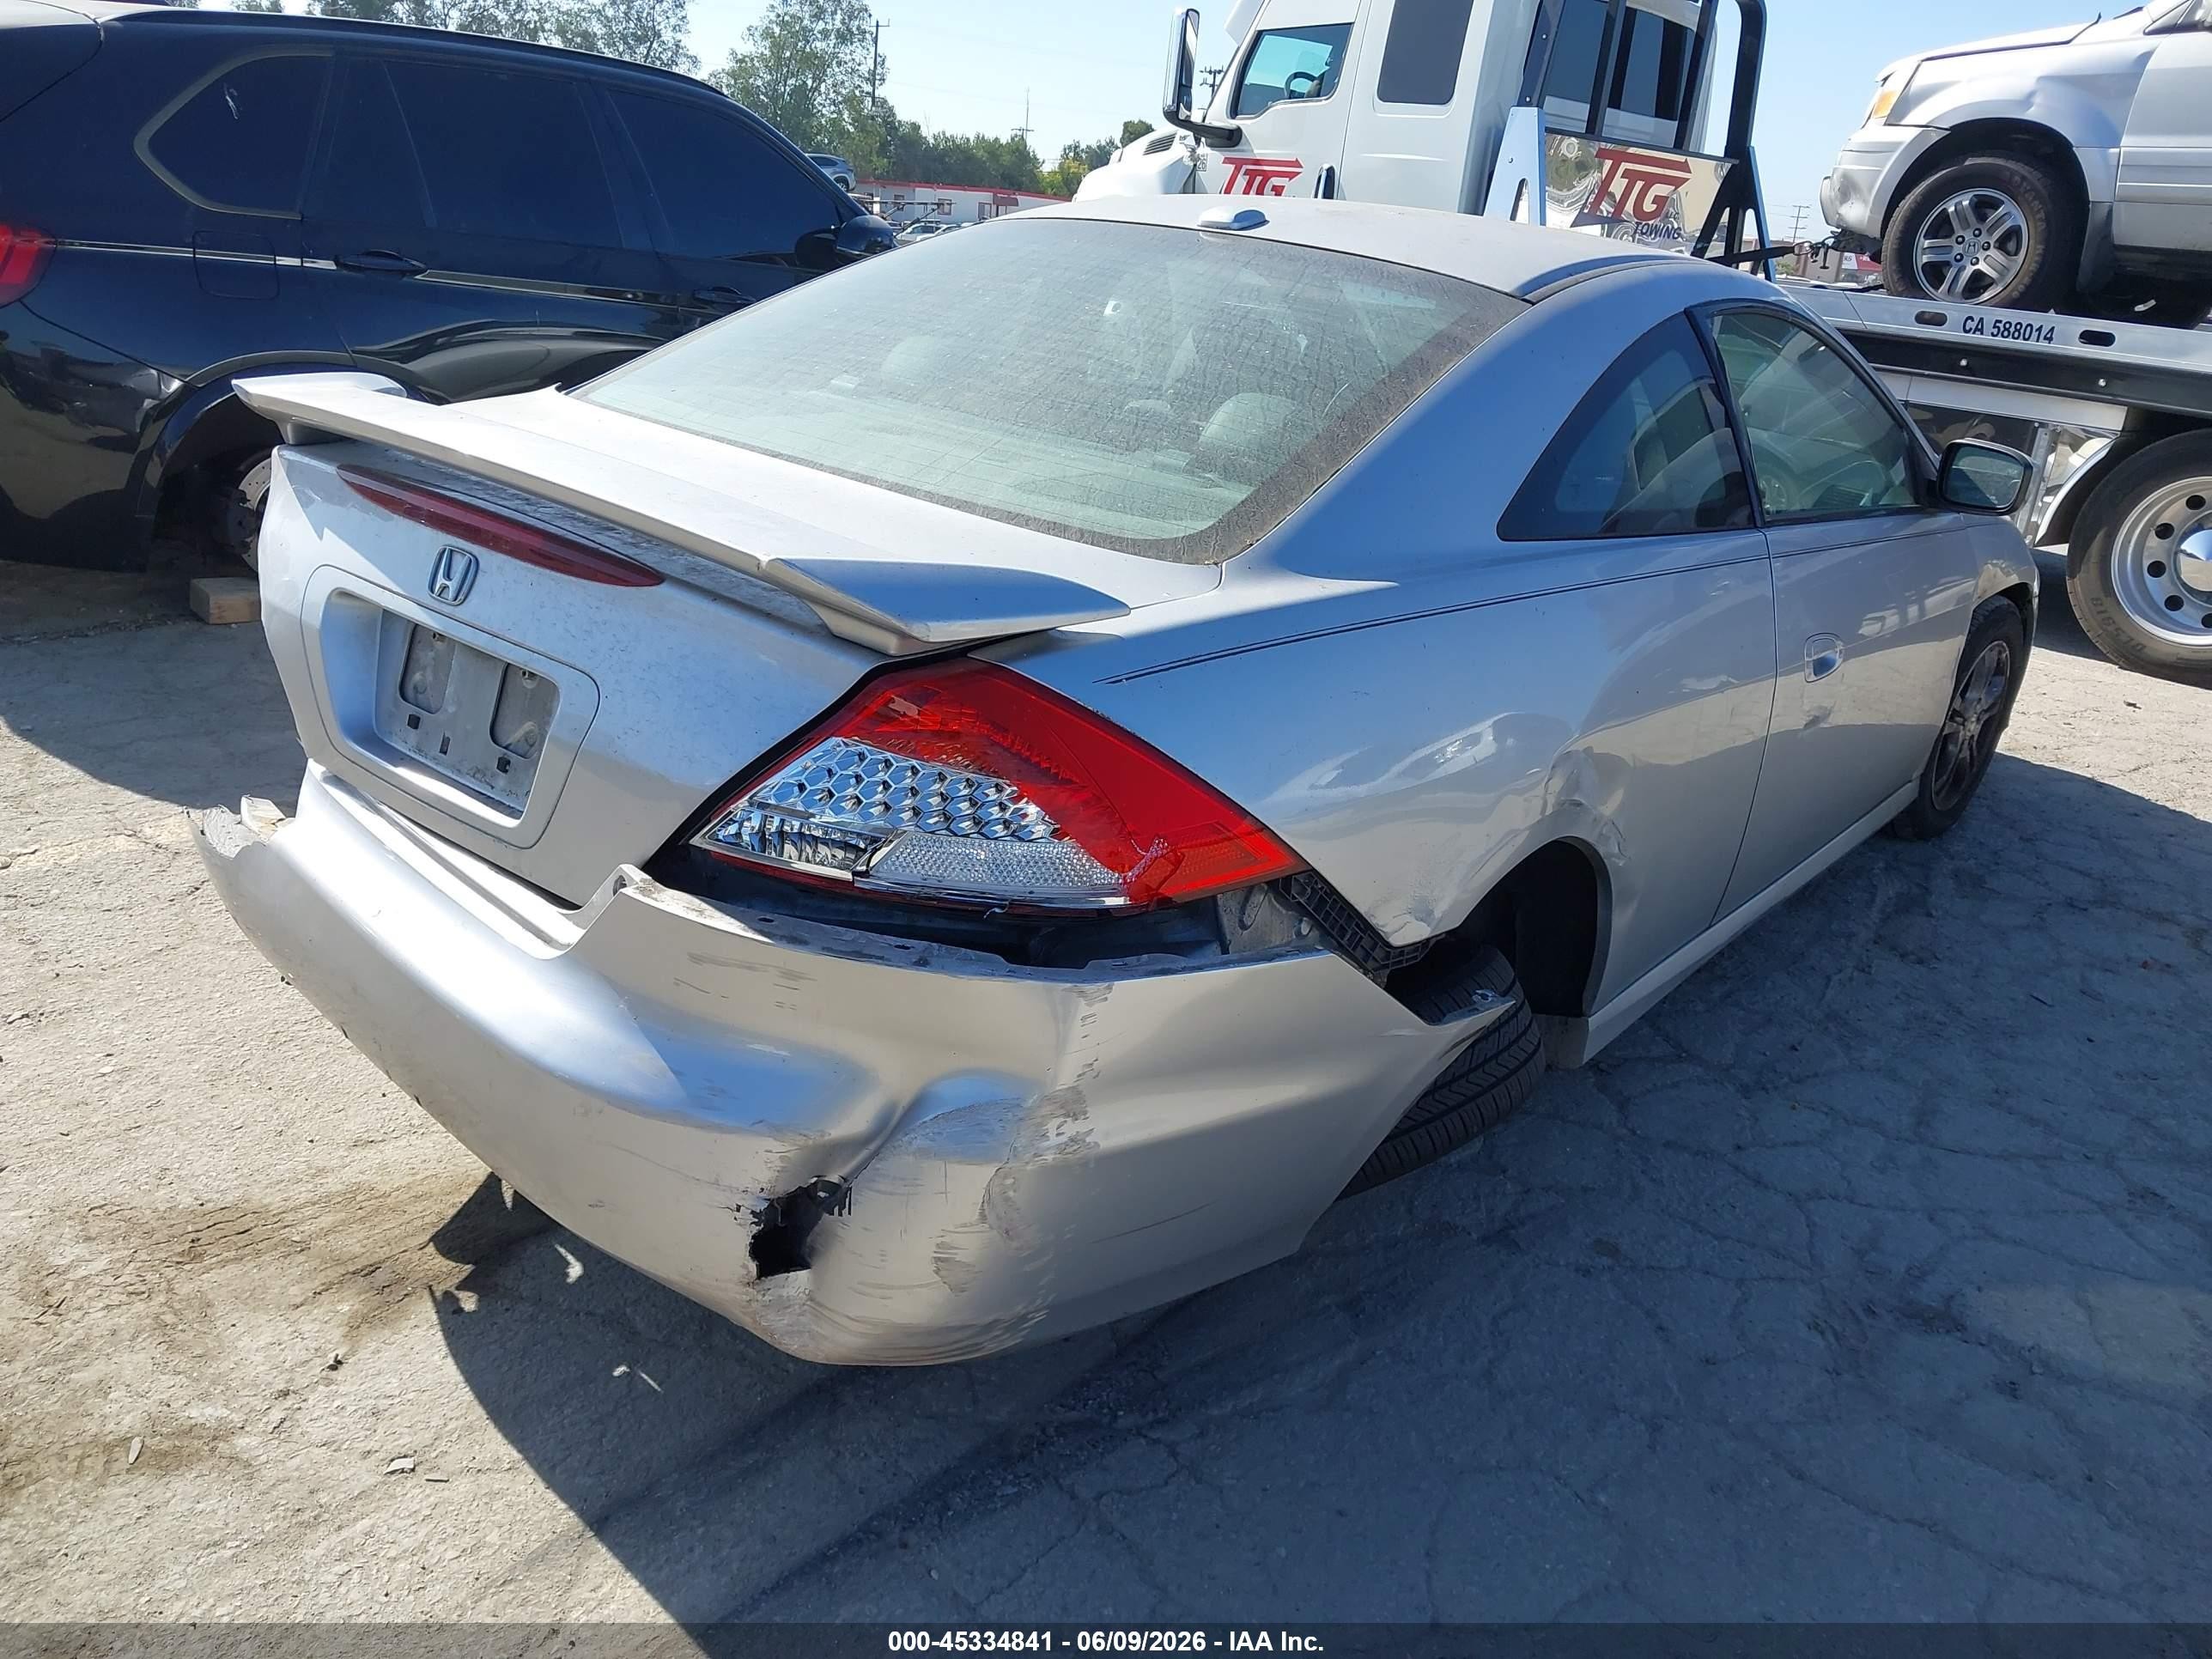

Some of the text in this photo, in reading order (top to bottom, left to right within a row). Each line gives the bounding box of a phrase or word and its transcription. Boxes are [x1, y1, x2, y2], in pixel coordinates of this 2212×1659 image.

[1595, 148, 1692, 222] TTG
[1633, 221, 1682, 240] TOWING
[1962, 315, 2056, 344] CA 588014
